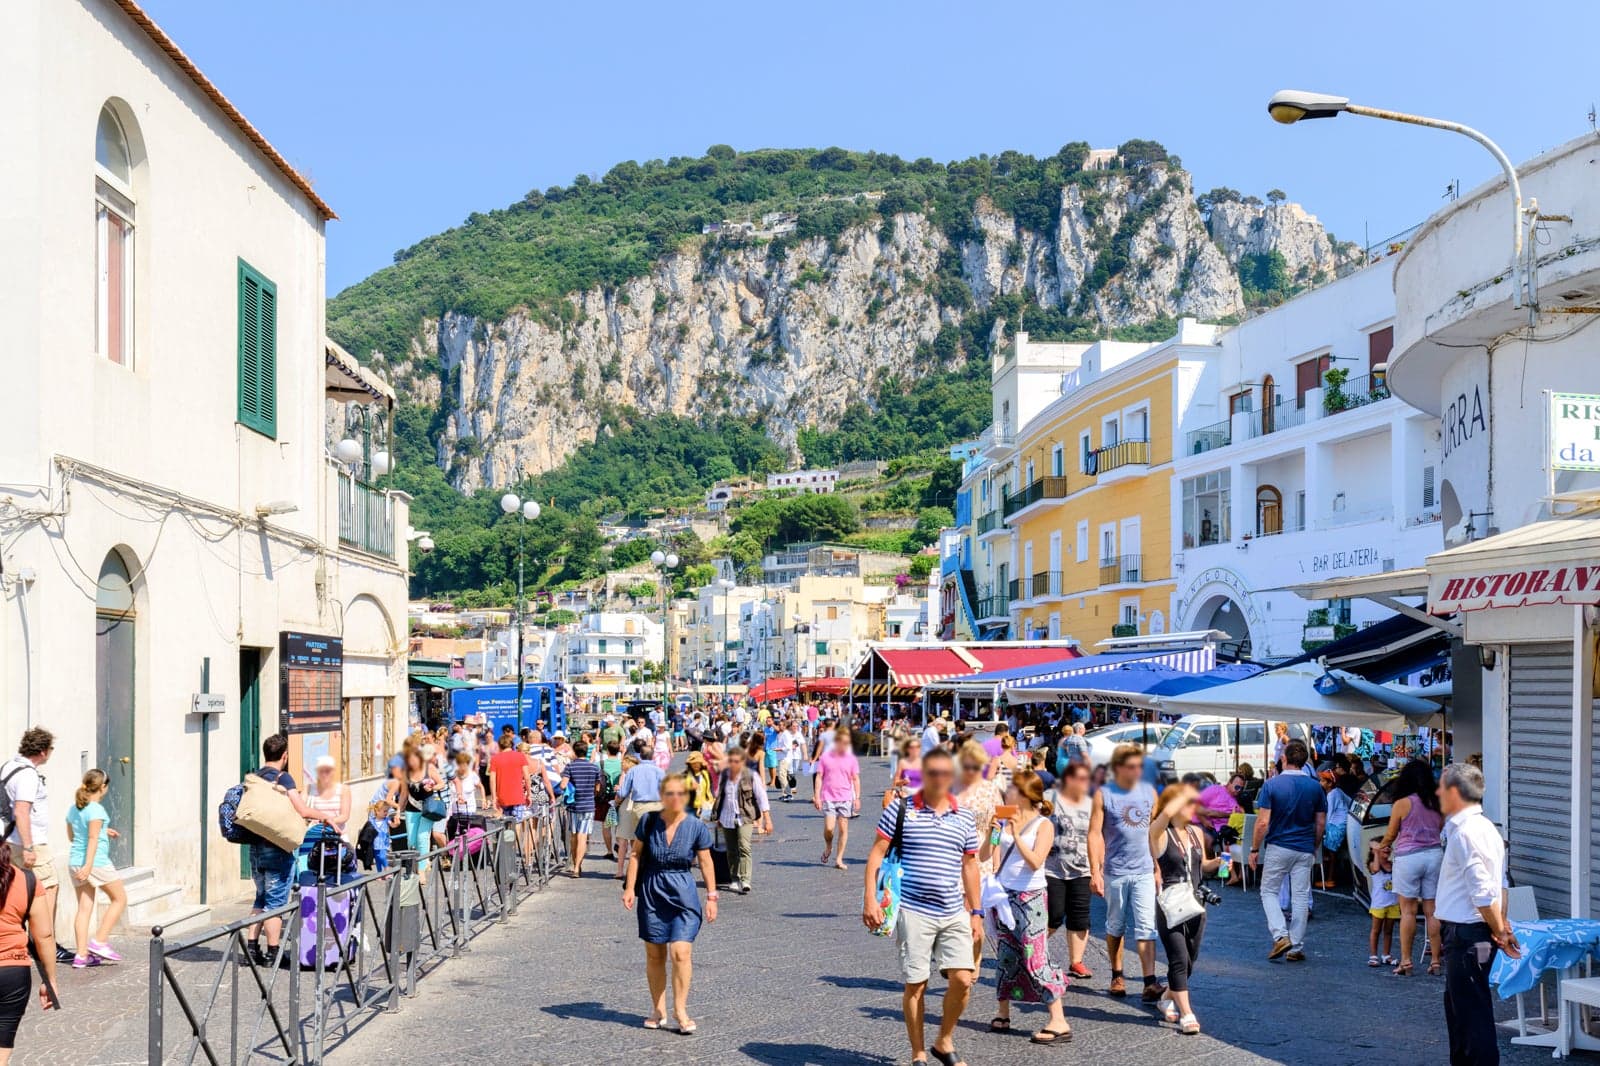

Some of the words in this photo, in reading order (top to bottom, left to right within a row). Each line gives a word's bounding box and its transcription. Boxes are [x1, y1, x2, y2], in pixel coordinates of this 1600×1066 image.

[1441, 384, 1486, 465] URRA
[1560, 442, 1595, 462] da
[1313, 555, 1329, 573] BAR
[1332, 547, 1378, 570] GELATERIA
[1057, 693, 1090, 702] PIZZA
[1094, 694, 1133, 705] SNACK
